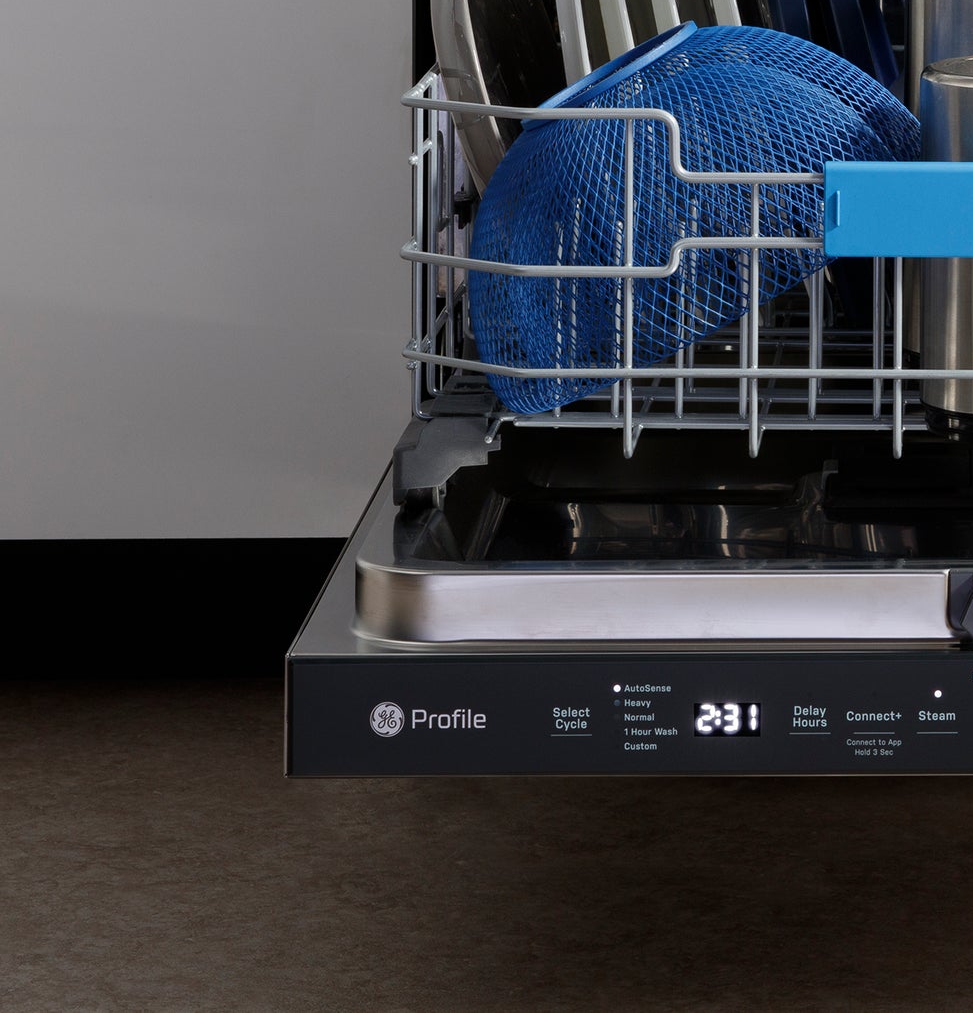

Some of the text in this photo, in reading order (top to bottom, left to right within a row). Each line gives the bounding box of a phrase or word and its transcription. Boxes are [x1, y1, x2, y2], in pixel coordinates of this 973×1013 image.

[624, 684, 671, 692] AutoSense
[625, 699, 651, 708] Heavy
[553, 707, 590, 717] Select
[794, 706, 826, 718] Delay
[847, 711, 901, 721] Connect+
[919, 711, 955, 720] Steam
[412, 709, 486, 729] Profile
[625, 713, 654, 721] Normal
[697, 703, 758, 732] 2:31
[556, 719, 587, 731] Cycle
[793, 717, 827, 727] Hours
[631, 727, 651, 736] Hour
[655, 727, 677, 735] Wash
[624, 742, 657, 750] Custom
[847, 738, 876, 746] Connect
[888, 738, 902, 747] App
[855, 748, 870, 756] Hold
[880, 748, 893, 756] Sec
